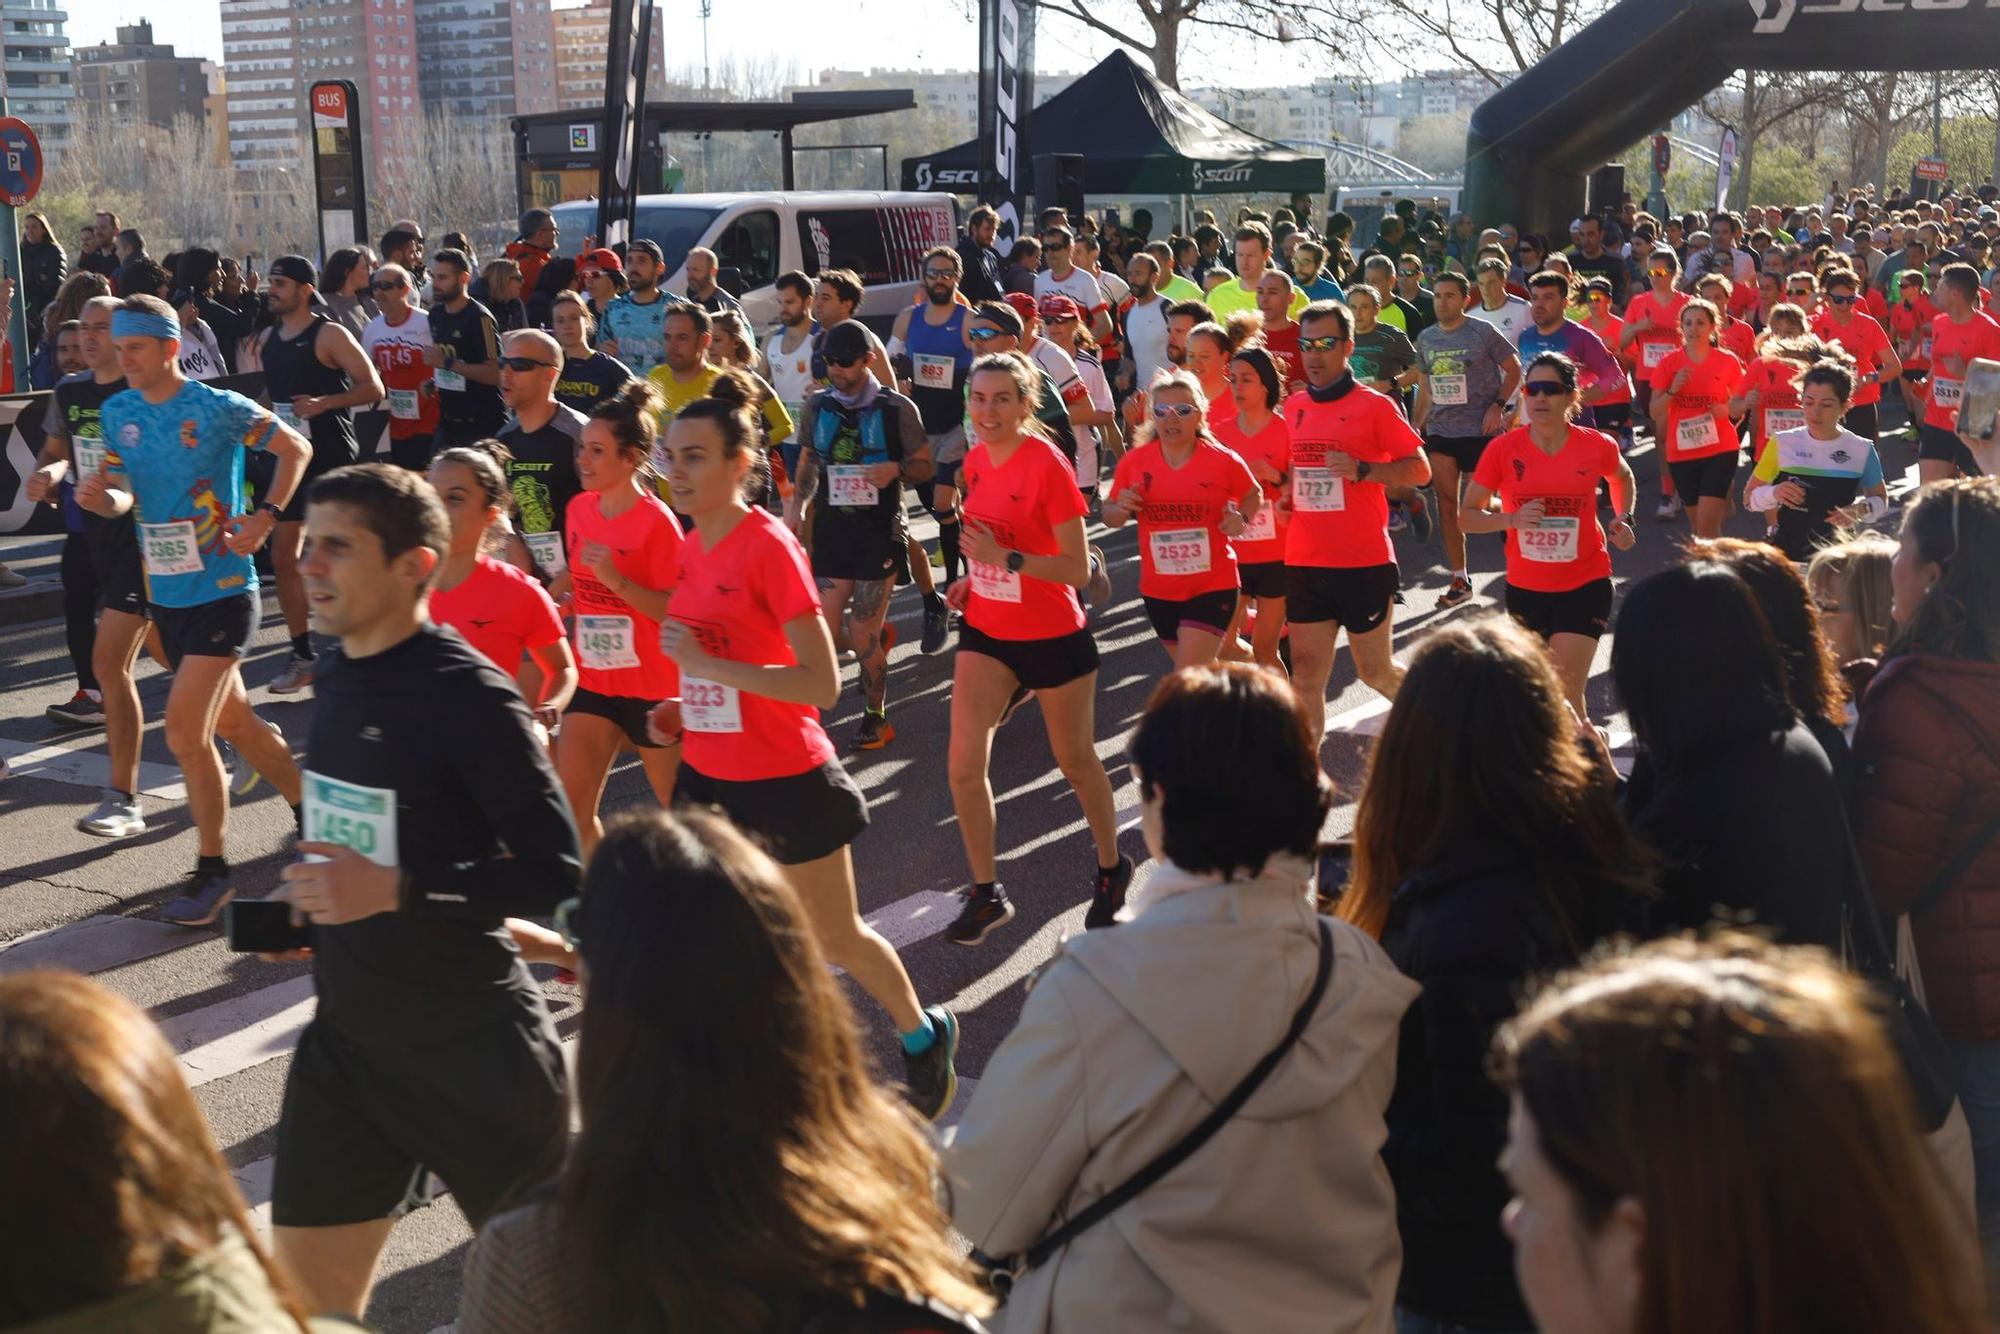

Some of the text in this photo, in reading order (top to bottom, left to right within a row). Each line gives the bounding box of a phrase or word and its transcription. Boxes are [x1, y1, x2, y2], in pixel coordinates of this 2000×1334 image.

[318, 93, 341, 107] BUS
[10, 154, 18, 168] P
[1204, 168, 1255, 182] SCOTT
[10, 195, 27, 206] BUS
[1435, 384, 1461, 395] 1529
[513, 463, 553, 471] SCOTT
[834, 477, 870, 492] 2731
[1297, 481, 1333, 496] 1727
[1524, 531, 1571, 546] 2287
[1158, 543, 1201, 560] 2523
[582, 632, 625, 651] 1493
